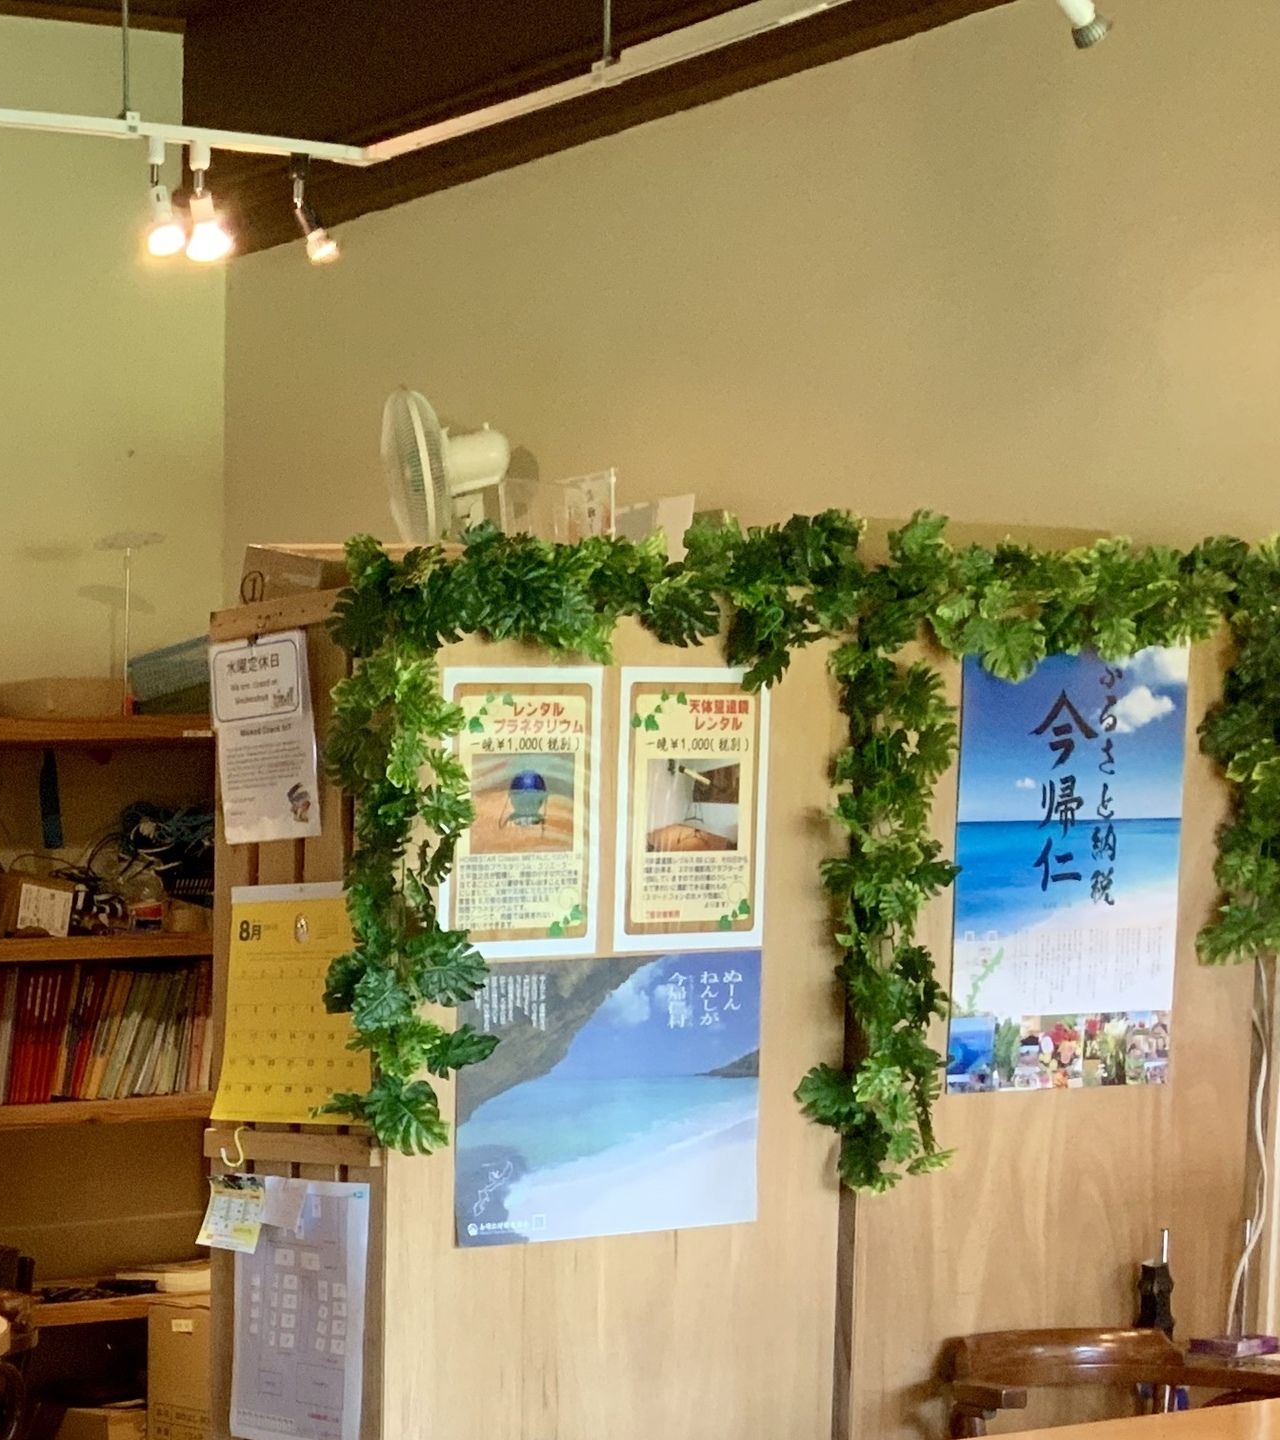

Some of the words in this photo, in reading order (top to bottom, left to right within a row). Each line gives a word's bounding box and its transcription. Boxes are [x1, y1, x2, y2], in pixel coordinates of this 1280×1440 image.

[513, 701, 565, 717] レンタル
[493, 719, 584, 735] プラネタリウム
[694, 716, 743, 732] レンタル
[1028, 688, 1099, 892] 今帰仁
[239, 920, 261, 941] 8月
[700, 971, 720, 1026] ねんしが
